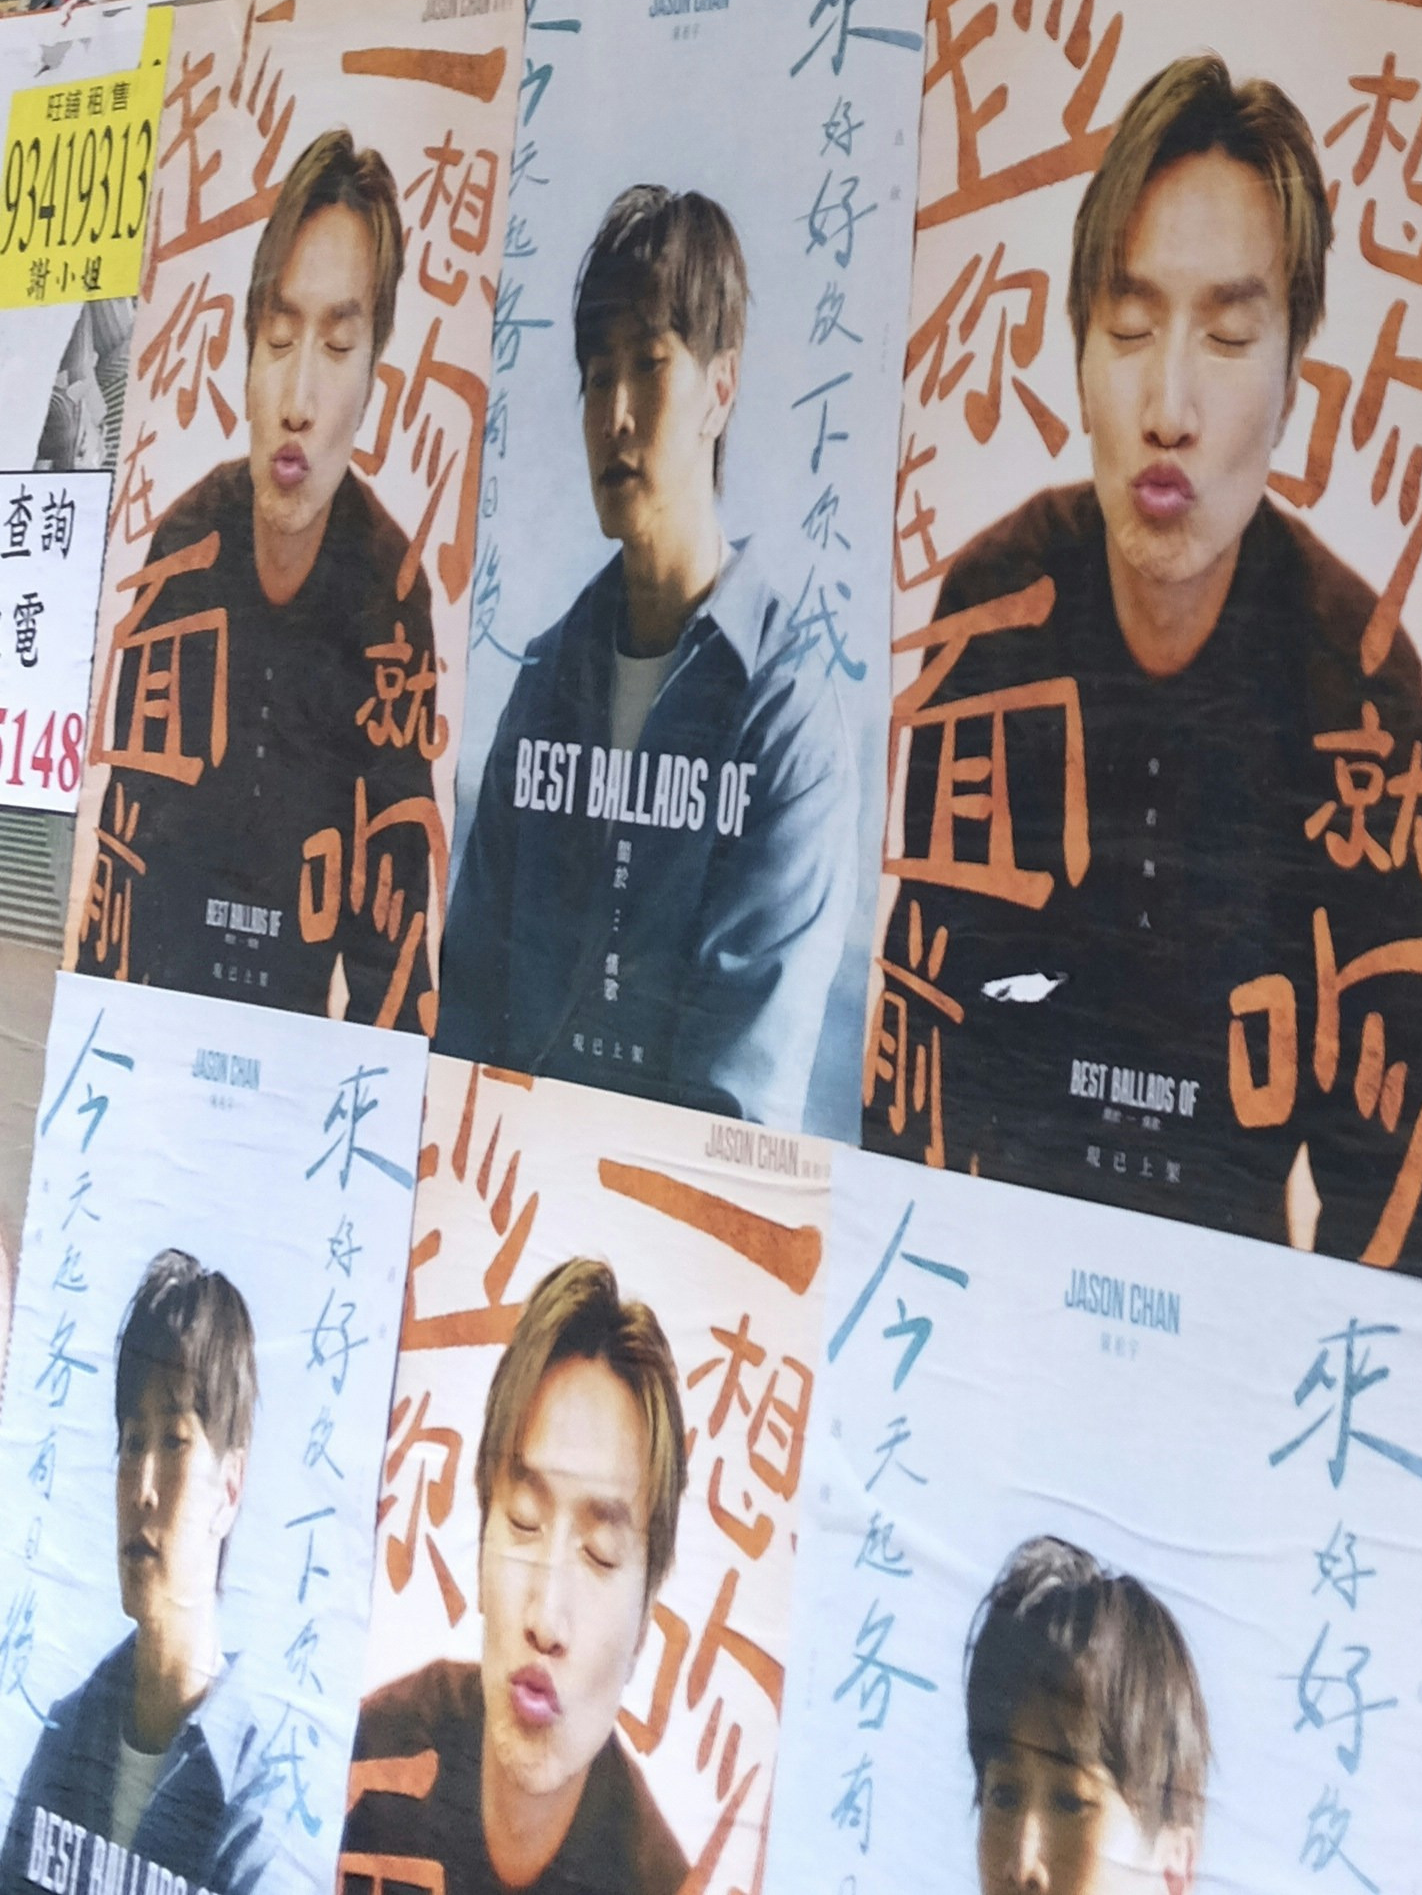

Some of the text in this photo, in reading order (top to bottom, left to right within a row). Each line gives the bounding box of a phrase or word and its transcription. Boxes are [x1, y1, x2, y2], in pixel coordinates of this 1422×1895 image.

[0, 118, 153, 256] 93419313
[513, 737, 757, 838] BEST BALLADS OF
[1069, 1057, 1109, 1102] BEST
[1109, 1065, 1176, 1115] BALLADS
[1178, 1077, 1200, 1119] OF
[703, 1120, 801, 1176] JASON CHAN
[1064, 1268, 1181, 1336] JASON CHAN
[26, 1805, 188, 1895] BEST BALL
